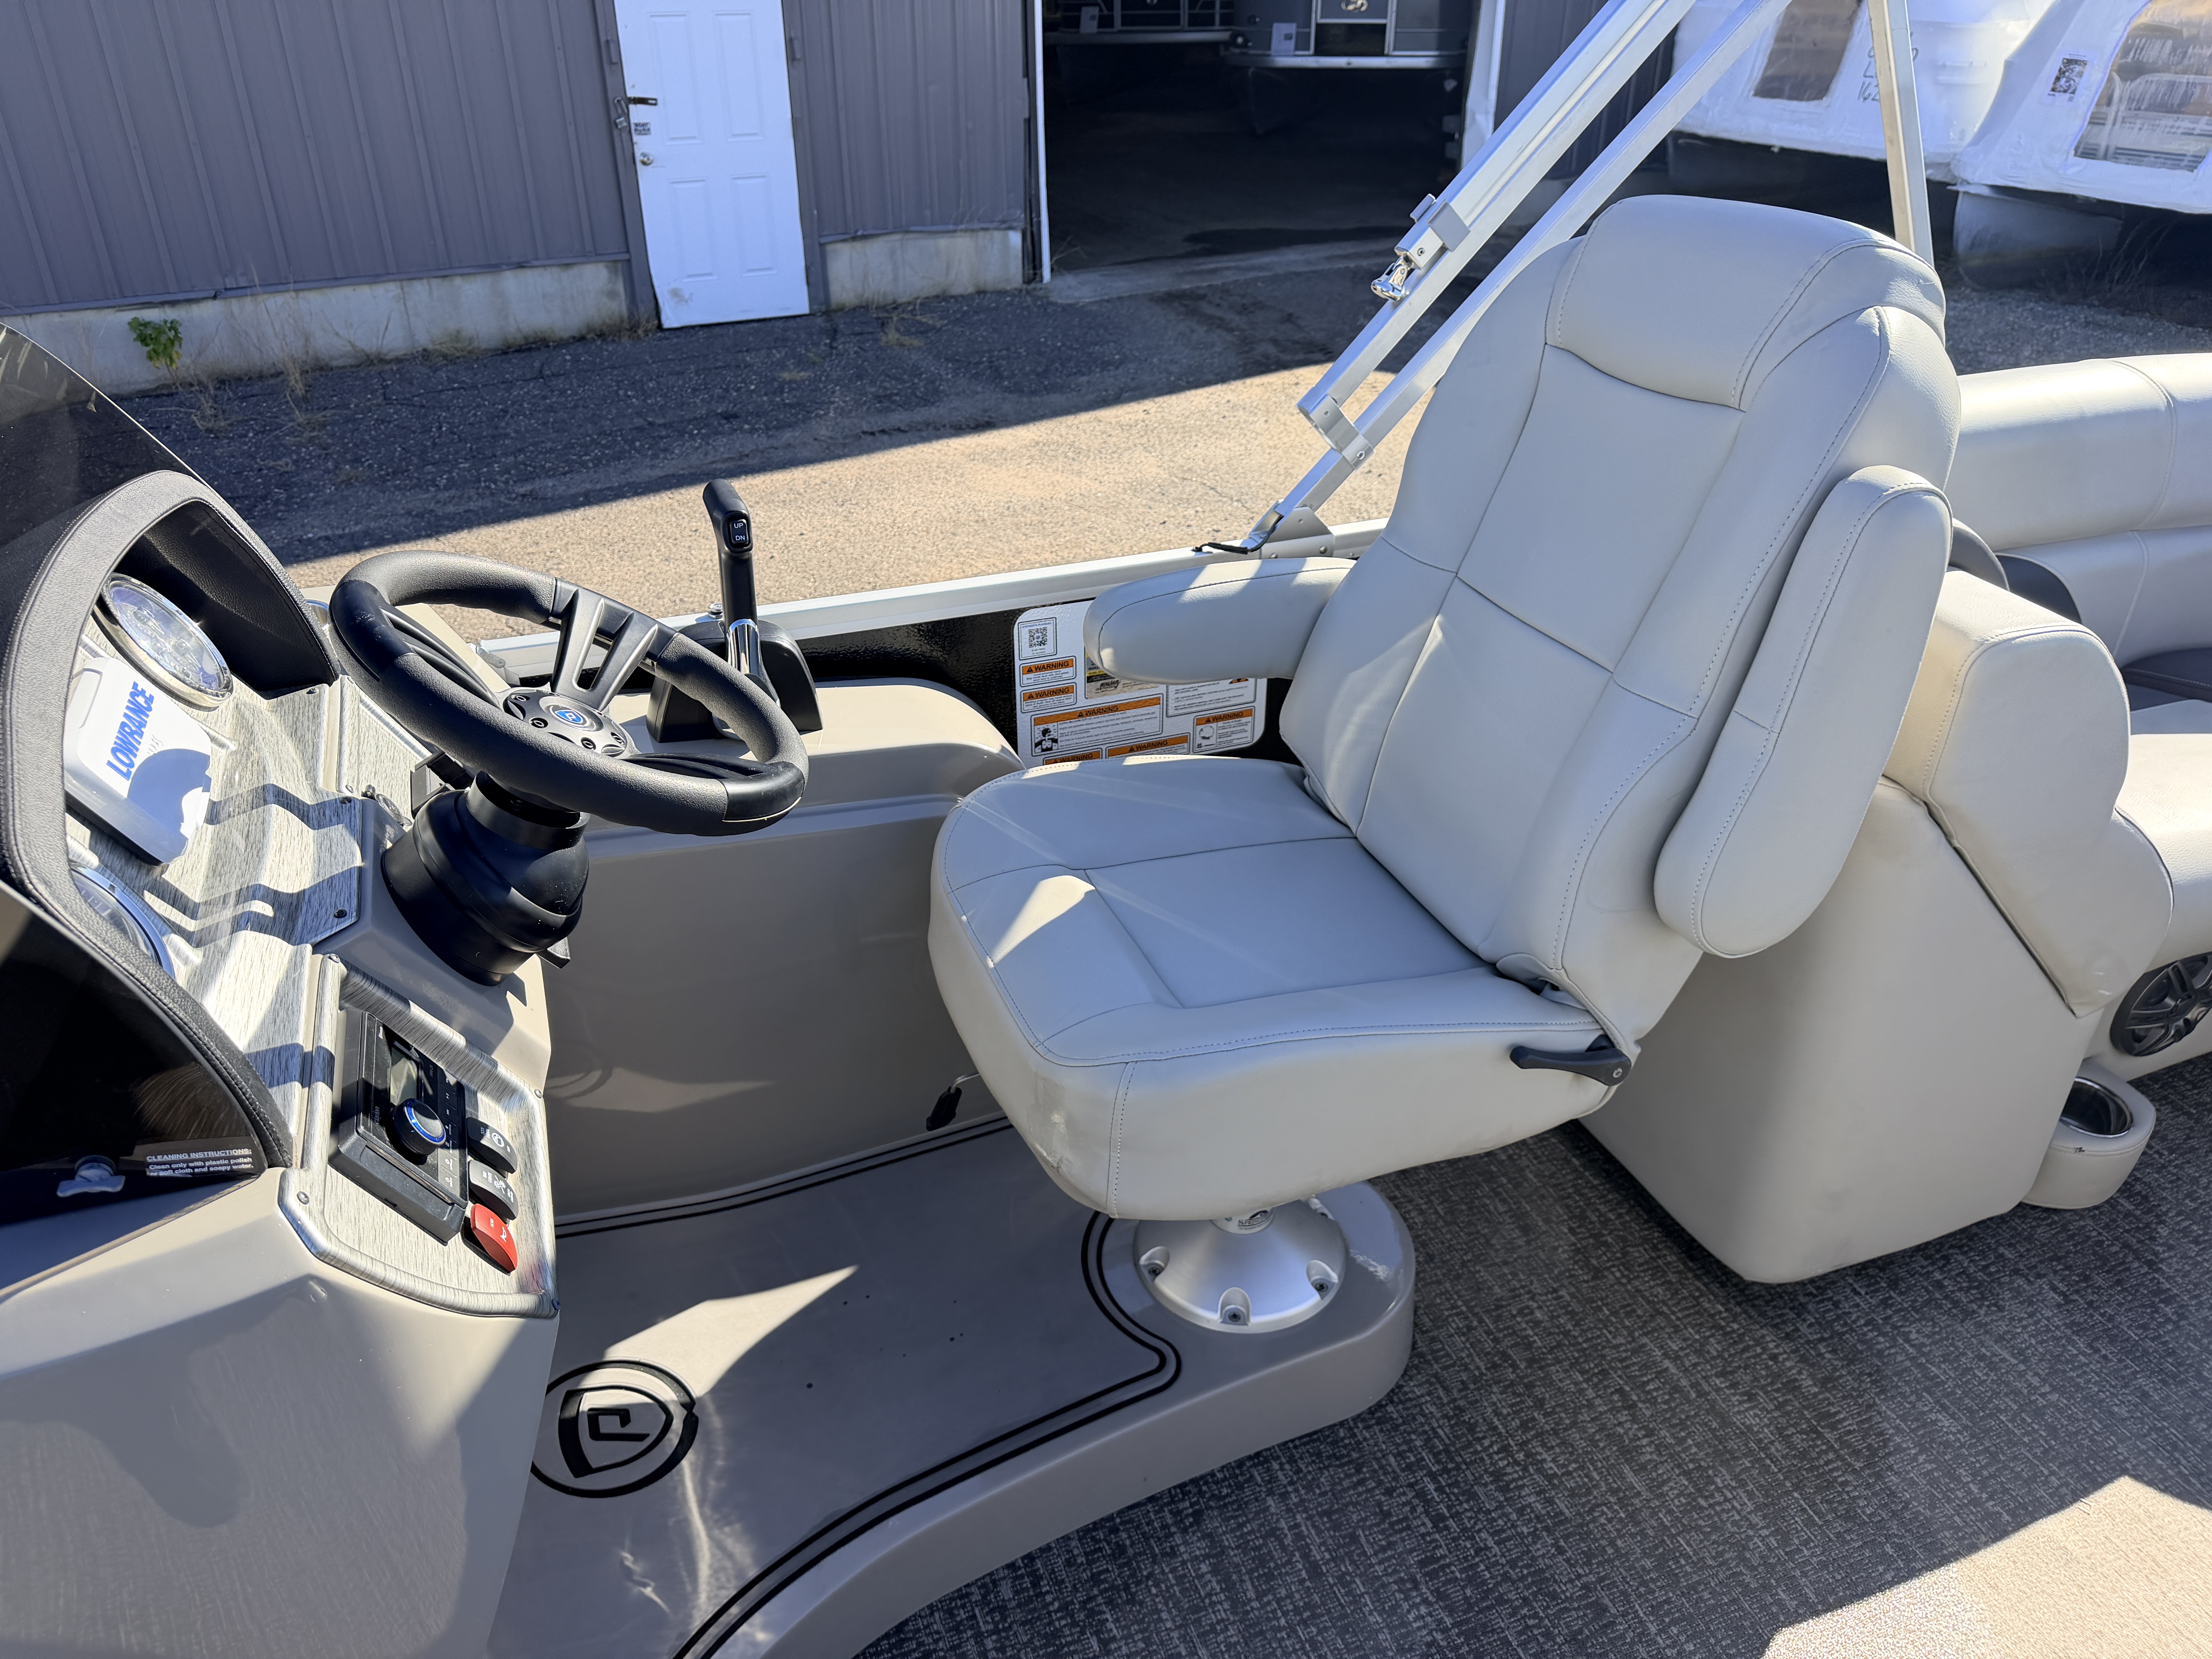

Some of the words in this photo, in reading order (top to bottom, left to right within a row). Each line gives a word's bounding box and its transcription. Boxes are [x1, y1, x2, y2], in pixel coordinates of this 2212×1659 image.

[1034, 661, 1069, 671] WARNING
[1035, 687, 1070, 697] WARNING
[1085, 705, 1118, 716] WARNING
[1212, 711, 1243, 722] WARNING
[106, 681, 155, 781] LOWRANCE
[1136, 740, 1168, 750] WARNING
[1060, 753, 1093, 763] WARNING
[146, 1153, 188, 1161] CLEANING
[190, 1148, 252, 1158] INSTRUCTIONS:
